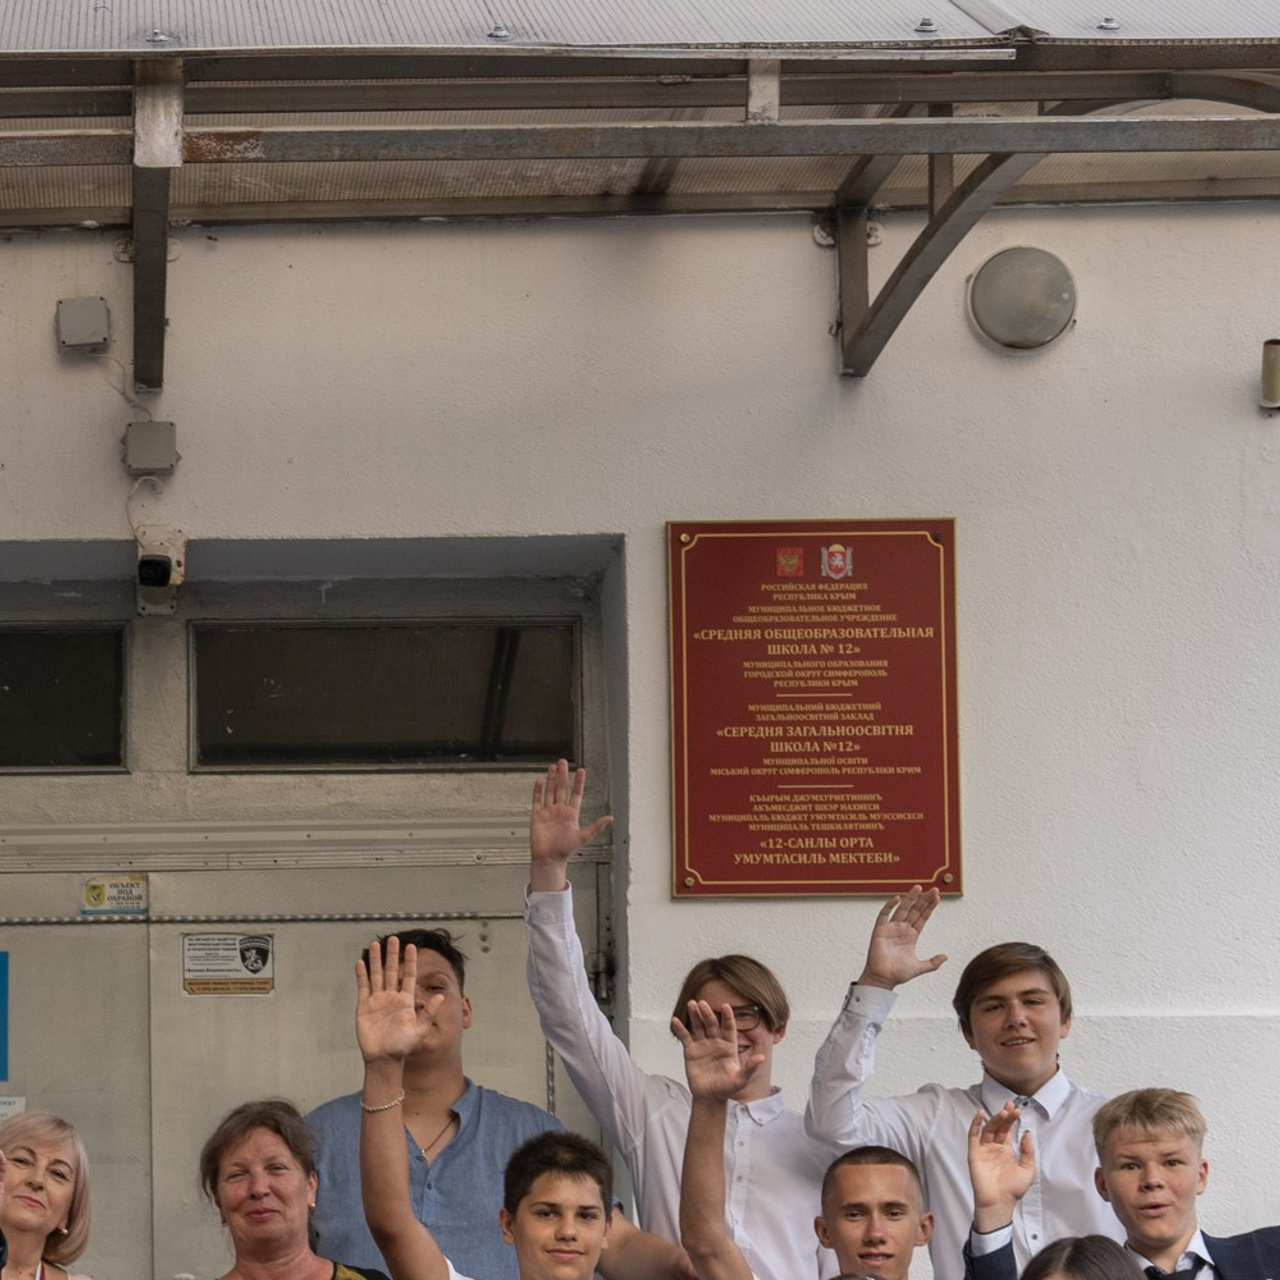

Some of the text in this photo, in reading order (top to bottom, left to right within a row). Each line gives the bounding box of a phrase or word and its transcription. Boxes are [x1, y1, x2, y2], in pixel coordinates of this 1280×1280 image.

[761, 582, 868, 592] РОССИЙСКАЯ ФЕДЕРАЦИЯ
[773, 592, 856, 601] РЕСПУБЛИКА КРЫМ
[748, 604, 881, 614] МУНИЦИПАЛЬНОЕ БЮДЖЕТНОЕ
[732, 614, 897, 623] ОБЩЕОБРАЗОВАТЕЛЬНОЕ УЧРЕЖДЕНИЕ
[694, 627, 934, 641] «СРЕДНЯЯ ОБЩЕОБРАЗОВАТЕЛЬНАЯ
[767, 643, 861, 656] ШКОЛА № 12»
[743, 659, 889, 669] МУНИЦИПАЛЬНОГО ОБРАЗОВАНИЯ
[744, 668, 888, 679] ГОРОДСКОЙ ОКРУГ СИМФЕРОПОЛЬ
[773, 678, 858, 688] РЕСПУБЛИКИ КРЫМ
[840, 712, 874, 722] ЗАКЛАД
[716, 724, 914, 739] «СЕРЕДНЯ ЗАГАЛЬНООСВІТНЯ
[770, 740, 861, 753] ШКОЛА №12»
[751, 767, 778, 776] ОКРУГ
[896, 766, 922, 775] КРИМ
[771, 813, 809, 822] БЮДЖЕТ
[760, 837, 874, 849] «12-САНЛЫ ОРТА
[734, 852, 900, 865] УМУМТАСИЛЬ МЕКТЕБИ»
